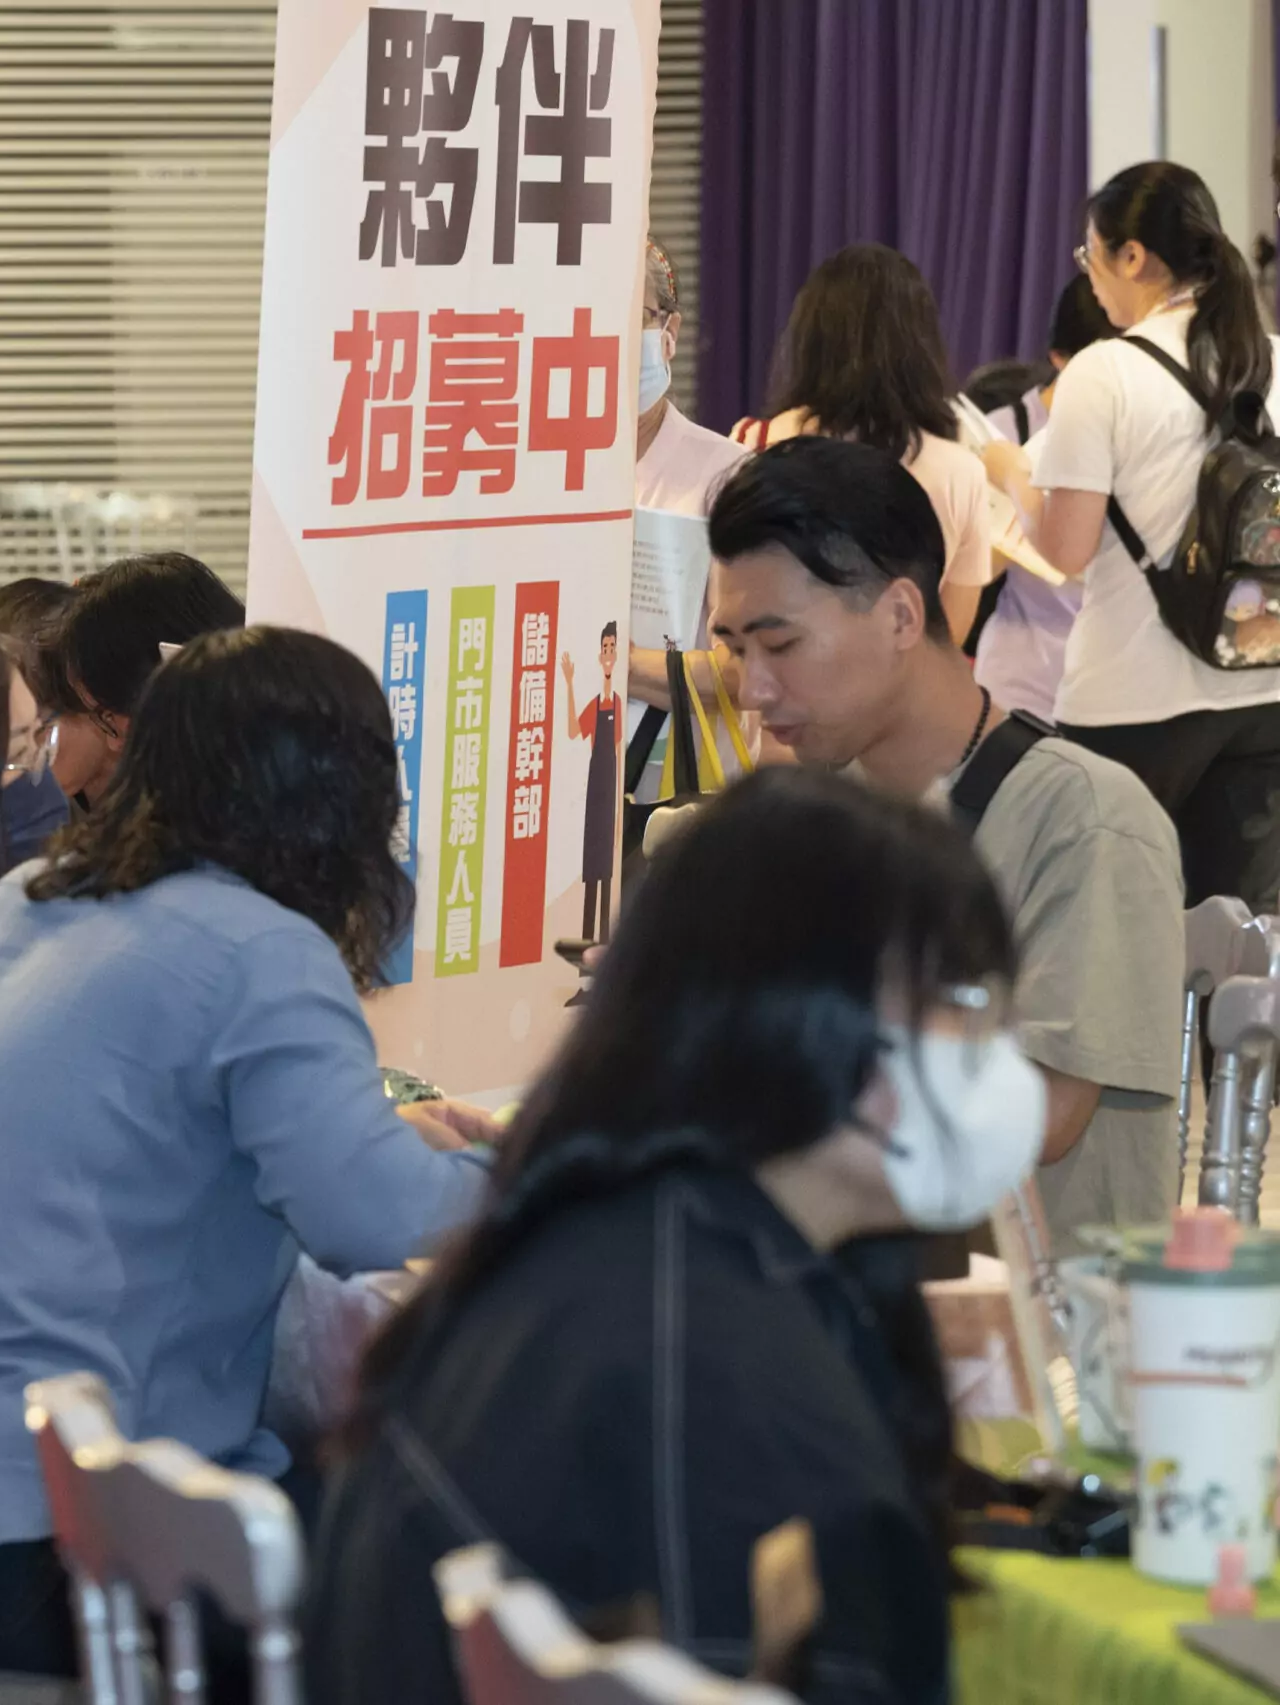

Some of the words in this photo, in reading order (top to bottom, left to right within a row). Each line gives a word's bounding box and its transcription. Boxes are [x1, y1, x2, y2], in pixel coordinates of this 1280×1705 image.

[358, 7, 616, 267] 夥伴
[327, 307, 621, 506] 招募中
[443, 617, 487, 963] 門市服務人員
[513, 612, 550, 840] 儲備幹部
